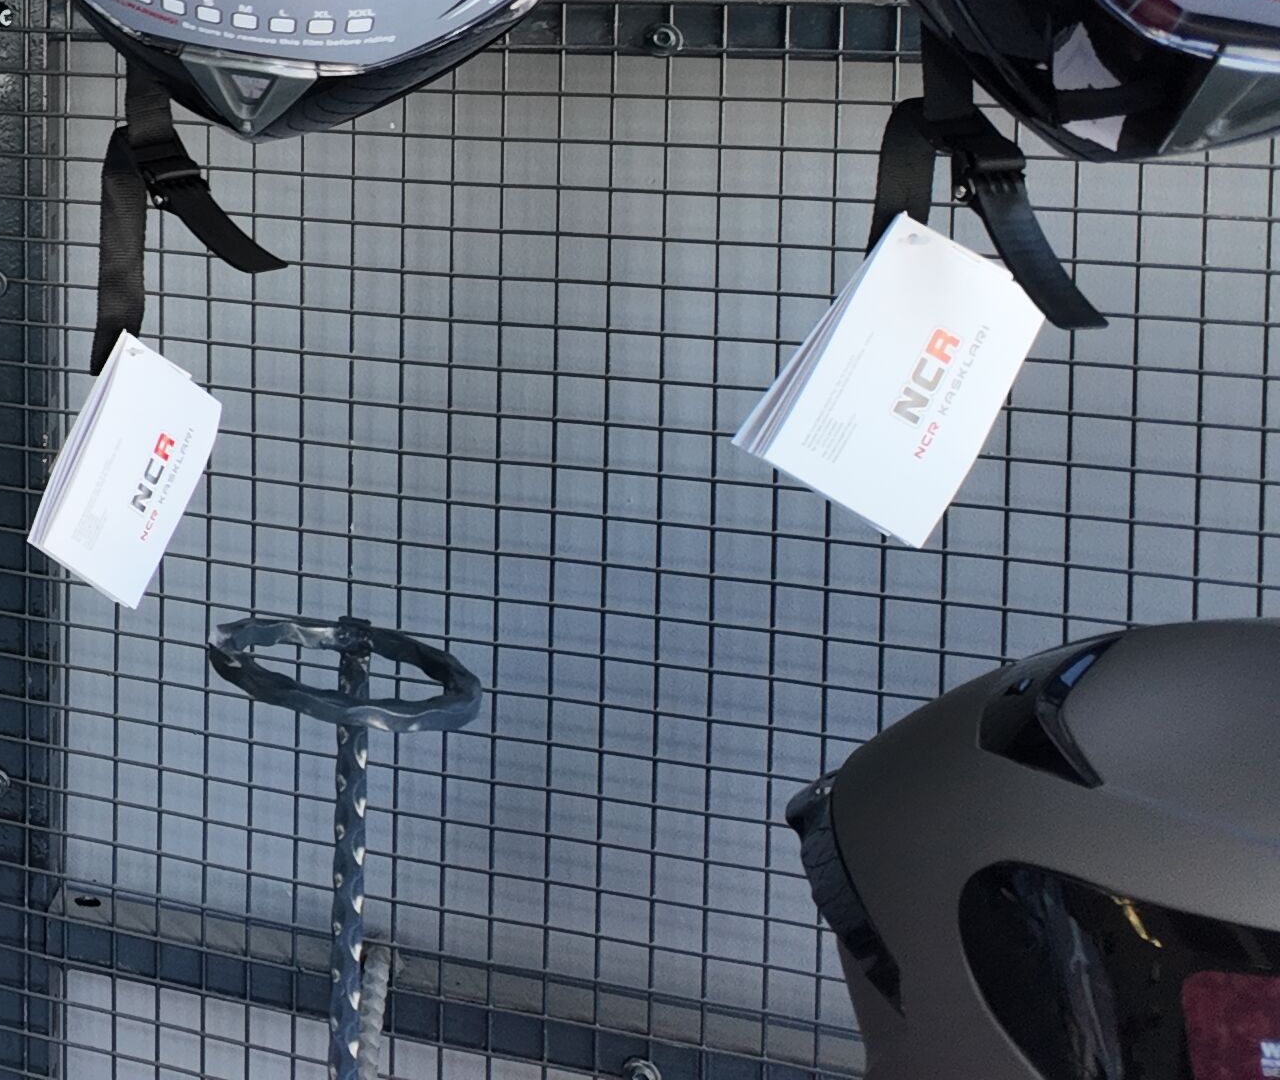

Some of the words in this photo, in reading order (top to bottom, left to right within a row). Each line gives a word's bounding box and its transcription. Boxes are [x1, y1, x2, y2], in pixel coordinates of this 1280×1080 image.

[238, 4, 252, 13] M
[314, 10, 332, 18] XL
[348, 9, 376, 17] XXL
[892, 328, 960, 425] NCR
[914, 421, 940, 459] NCR
[940, 324, 990, 416] KASKLARI
[130, 432, 176, 512] NCR
[140, 509, 158, 542] NCR
